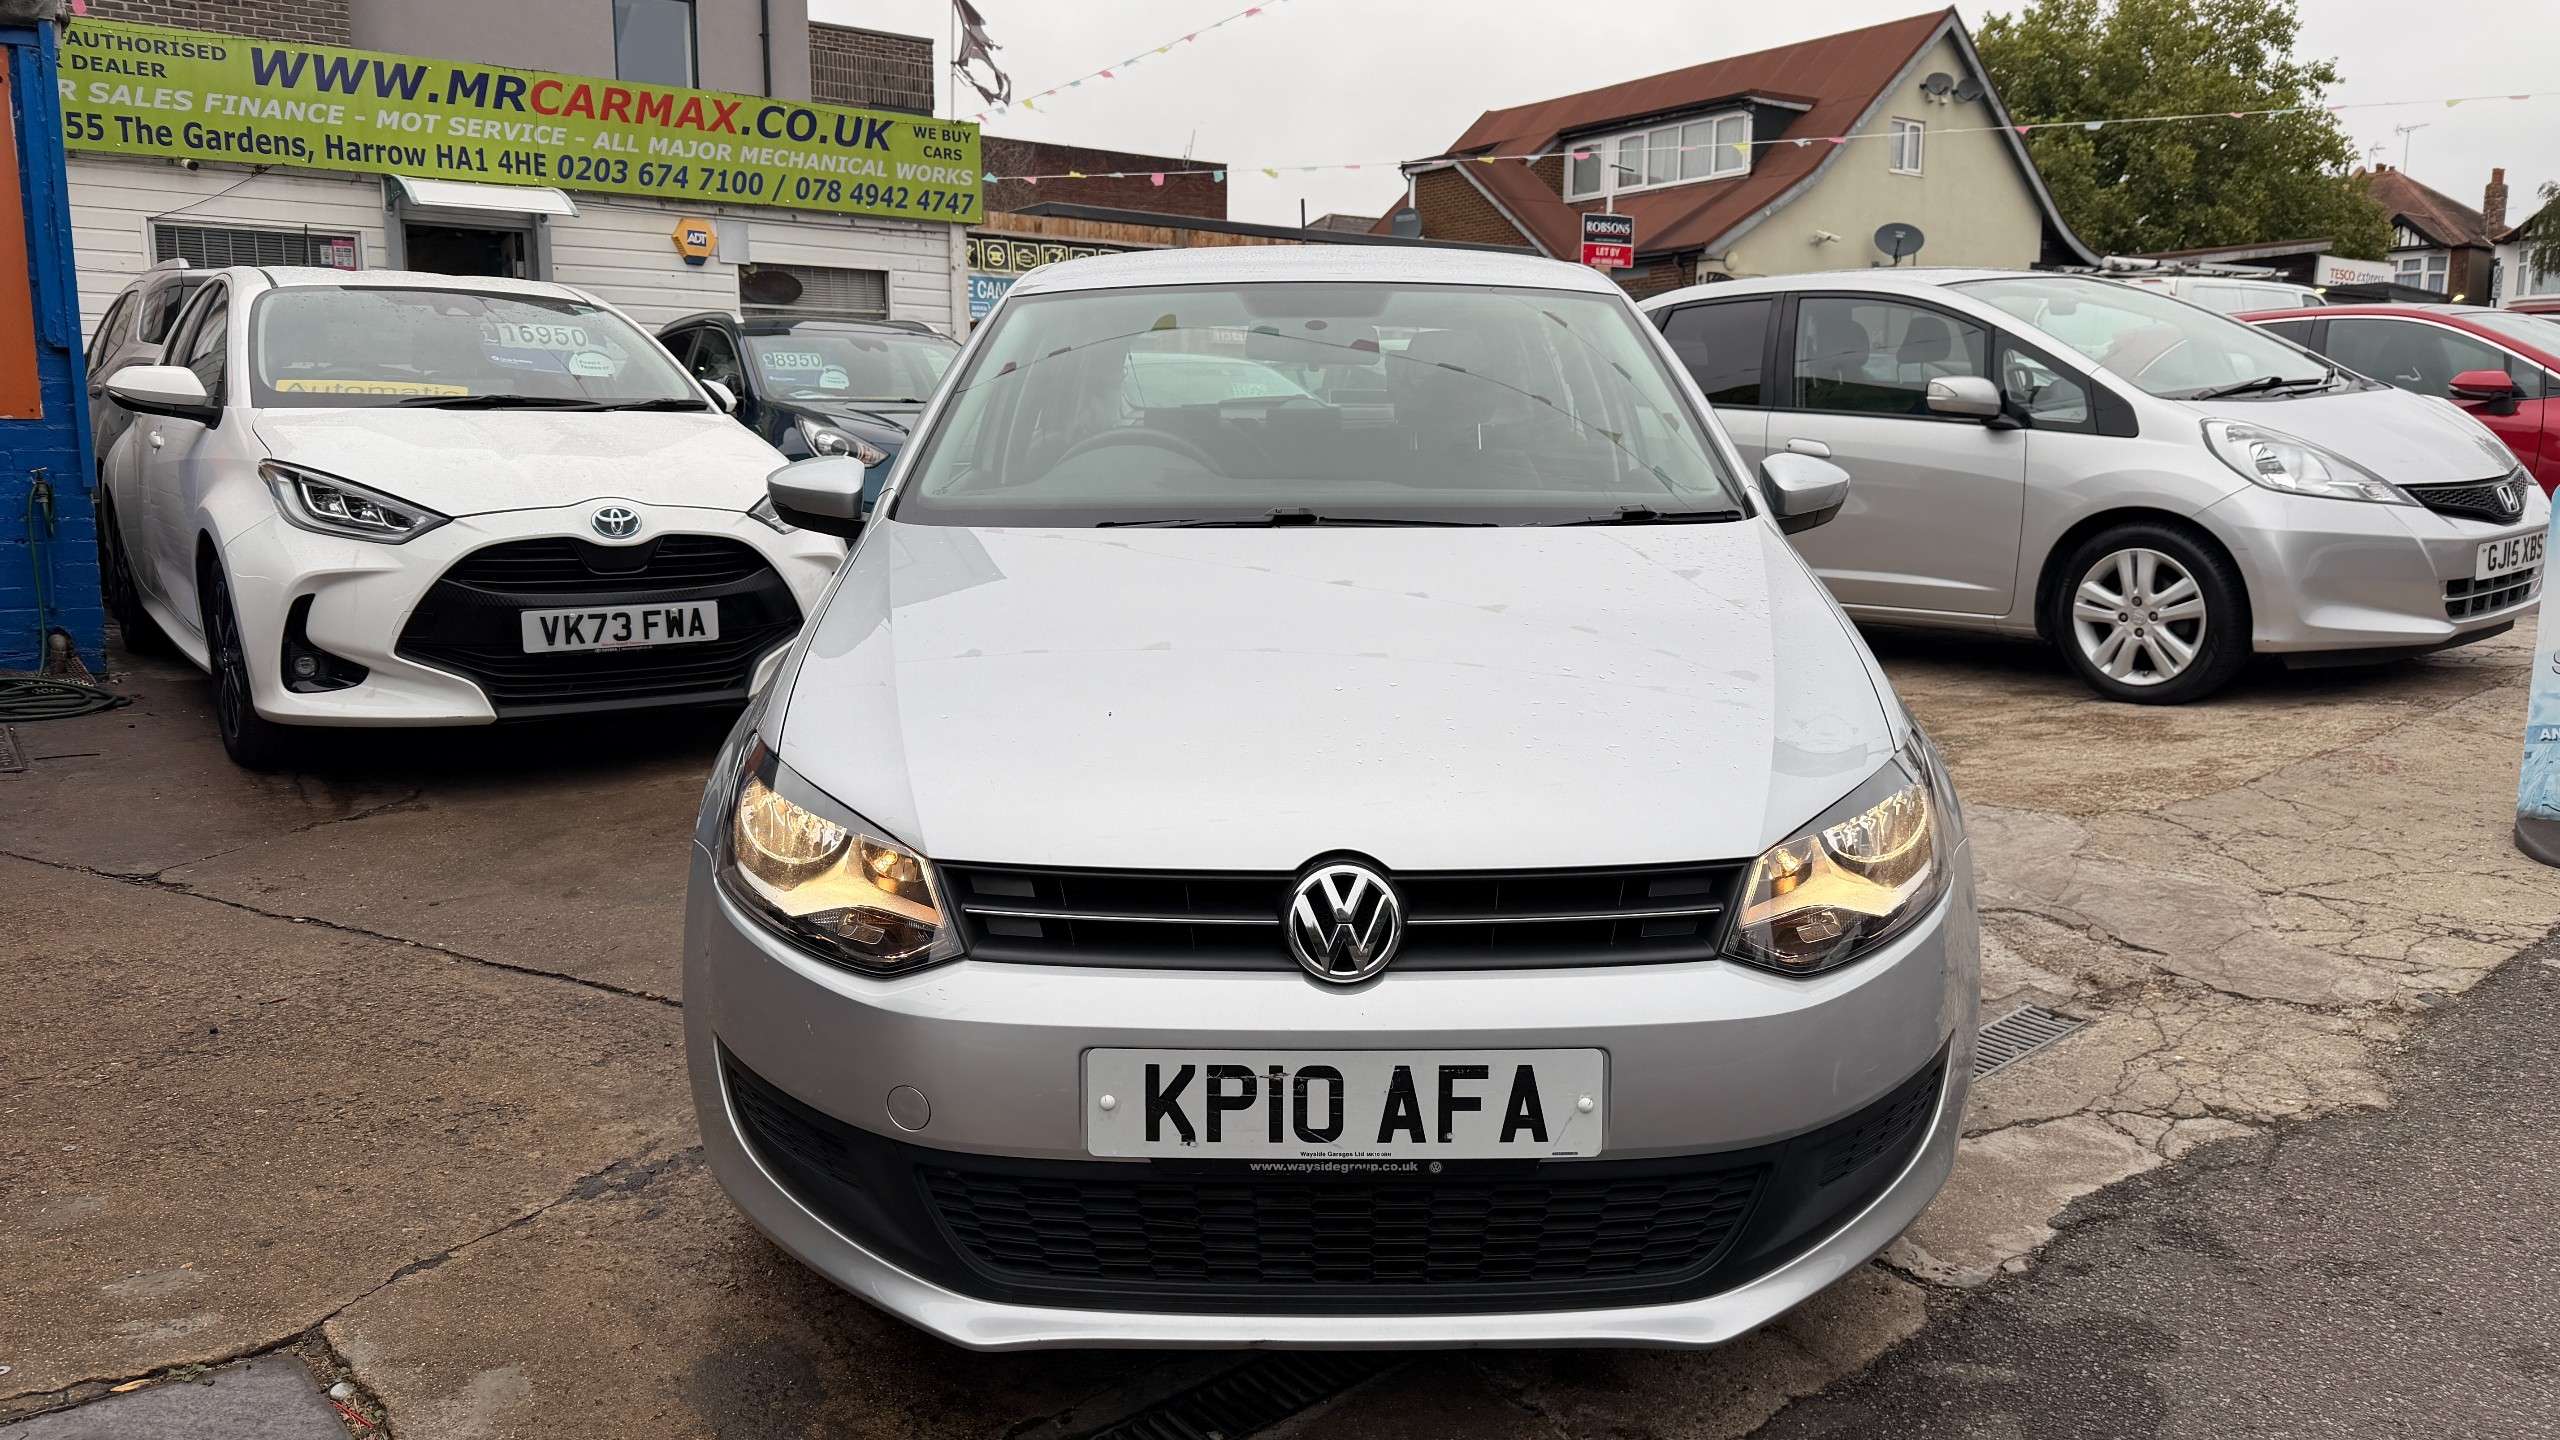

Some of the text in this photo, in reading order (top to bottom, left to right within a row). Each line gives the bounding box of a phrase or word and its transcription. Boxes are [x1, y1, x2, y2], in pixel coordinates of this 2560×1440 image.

[66, 30, 227, 61] AUTHORISED
[72, 54, 168, 78] DEALER
[251, 46, 895, 152] WWW.MRCARMAX.CO.UK
[88, 82, 193, 112] SALES
[204, 93, 345, 125] FINANCE
[376, 109, 441, 134] MOT
[447, 117, 567, 146] SERVICE
[593, 131, 640, 153] ALL
[648, 136, 732, 162] MAJOR
[740, 146, 887, 178] MECHANICAL
[896, 162, 973, 186] WORKS
[913, 126, 972, 144] WE BUY
[114, 115, 173, 147] The
[183, 121, 314, 163] Gardens,
[325, 133, 426, 167] Harrow
[436, 143, 489, 172] HA1
[498, 150, 547, 177] 4HE
[557, 154, 629, 184] 0203
[638, 162, 688, 189] 674
[699, 167, 764, 195] 7100
[772, 174, 786, 201] /
[796, 176, 842, 203] 078
[850, 182, 908, 209] 4942
[916, 189, 974, 215] 4747
[923, 146, 962, 161] CARS
[687, 231, 706, 245] ADT
[1586, 220, 1631, 234] ROBSONS
[1595, 246, 1609, 256] LET
[2330, 267, 2355, 282] TESCO
[2487, 533, 2544, 571] GJ15 XBS
[540, 607, 706, 646] VK73 FWA
[1144, 1063, 1549, 1147] KP10 AFA
